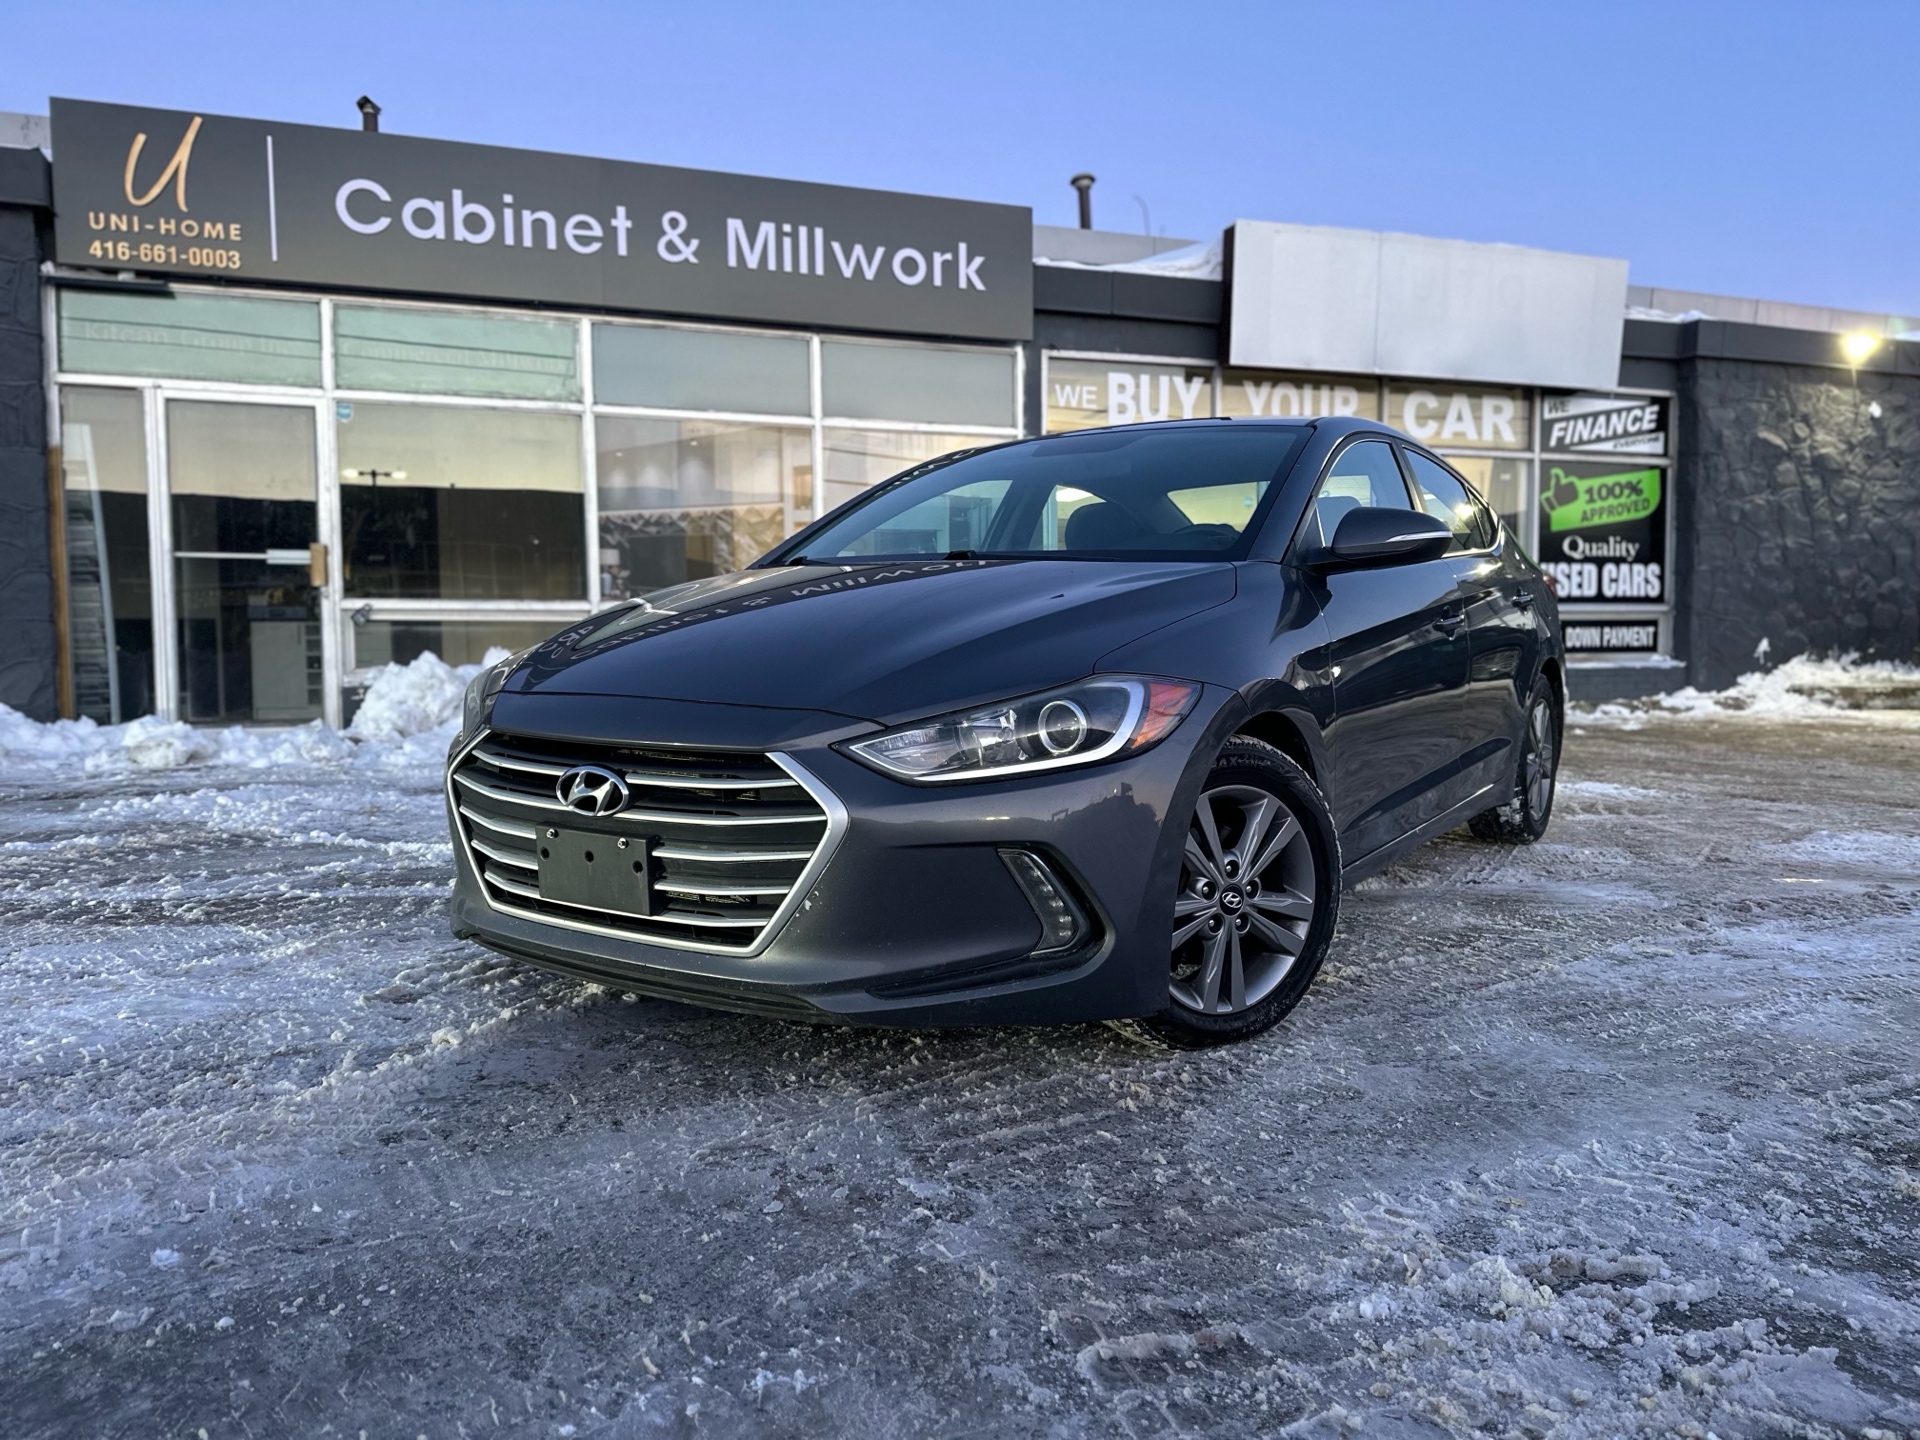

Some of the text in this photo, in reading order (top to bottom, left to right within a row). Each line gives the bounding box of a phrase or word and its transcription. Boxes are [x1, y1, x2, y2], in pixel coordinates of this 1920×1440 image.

[88, 211, 243, 241] UNI-HOME
[335, 178, 987, 292] Cabinet & Millwork
[88, 239, 242, 270] 416-661-0003
[1055, 371, 1516, 443] WE BUY YOUR CAR
[1547, 398, 1571, 414] WE
[1549, 403, 1661, 448] FINANCE
[1584, 478, 1644, 505] 100%
[1580, 498, 1652, 523] APPROVED
[1562, 533, 1641, 562] Quality
[1601, 561, 1662, 599] CARS
[1564, 625, 1656, 649] DOWN PAYMENT
